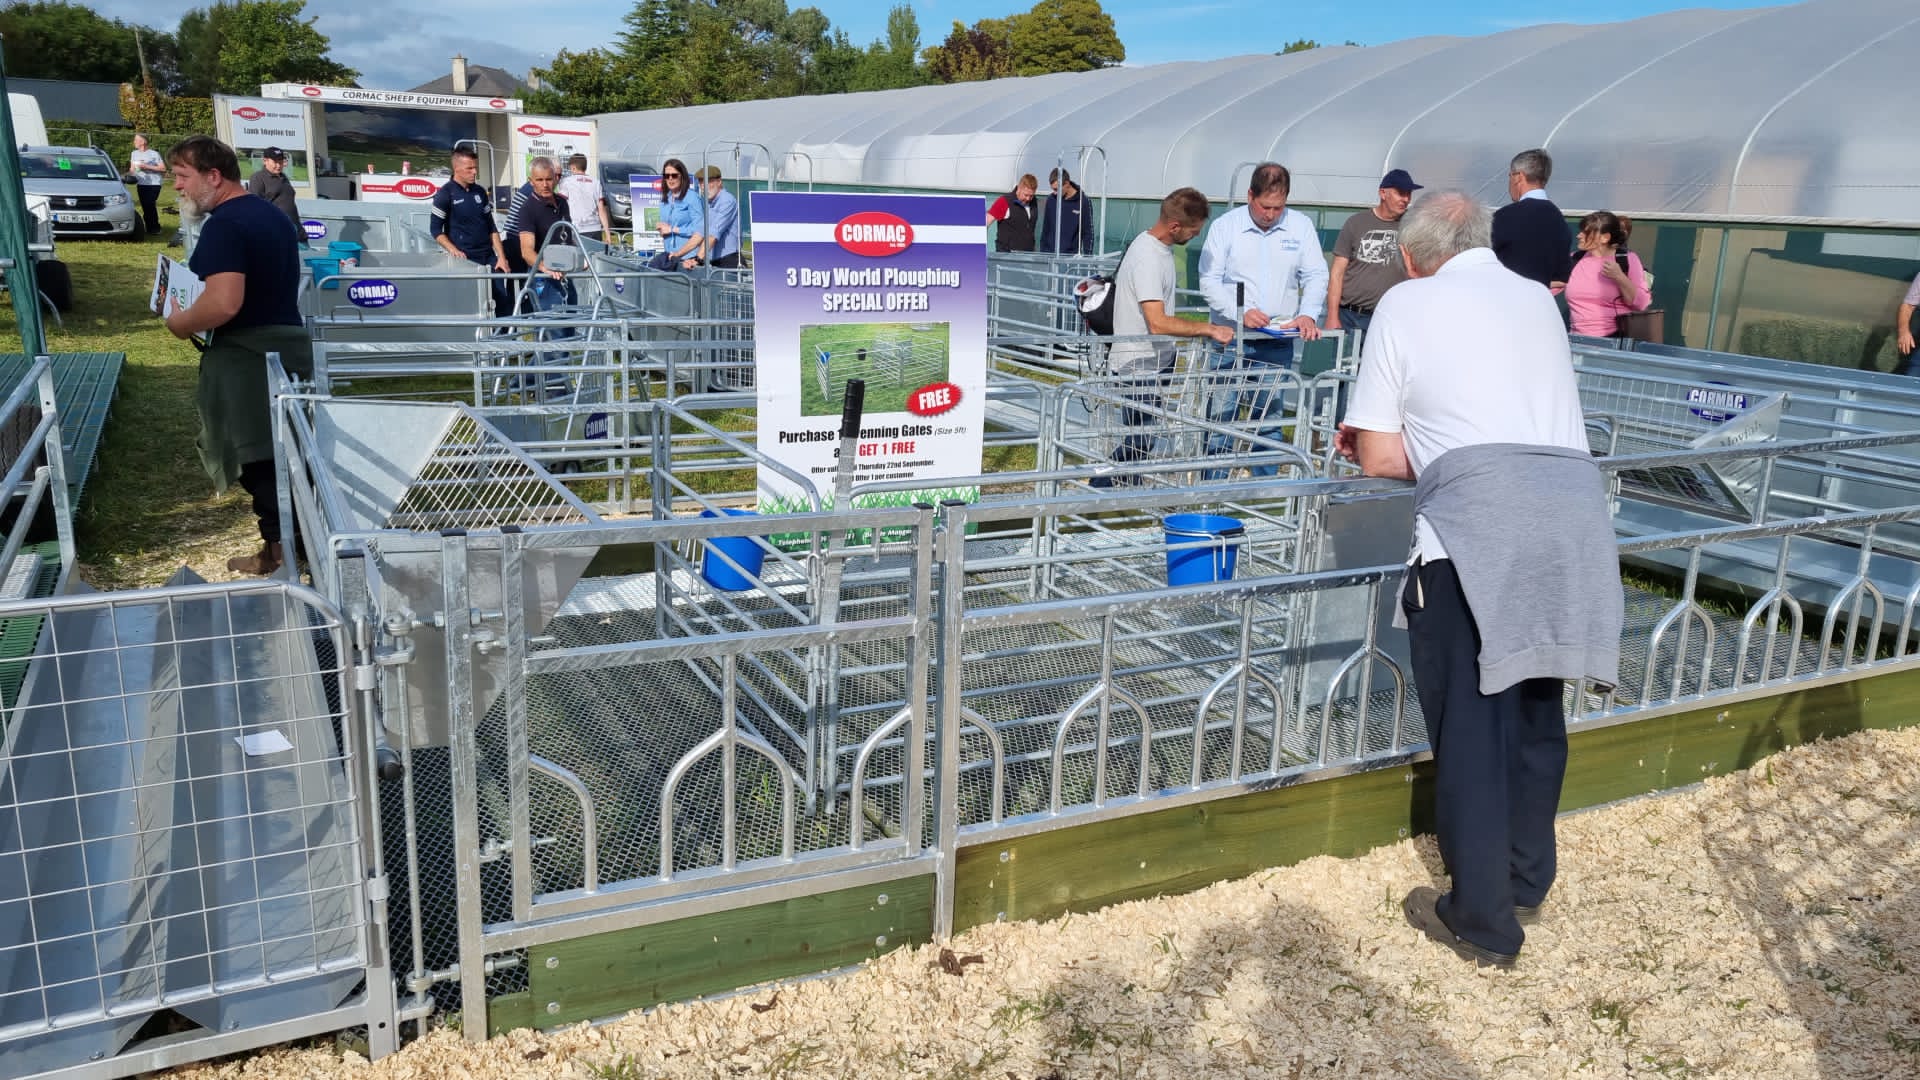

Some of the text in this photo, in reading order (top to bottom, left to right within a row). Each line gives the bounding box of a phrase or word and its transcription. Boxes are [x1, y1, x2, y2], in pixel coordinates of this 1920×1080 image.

[342, 91, 469, 106] CORMAC SHEEP EQUIPMENT
[243, 127, 259, 135] Lamb
[532, 139, 550, 148] Sheep
[402, 184, 431, 194] CORMAC
[842, 223, 906, 243] CORMAC
[786, 267, 961, 289] 3 Day World Ploughing
[350, 285, 395, 299] CORMAC
[822, 292, 929, 313] SPECIAL OFFER
[918, 388, 951, 411] FREE
[1690, 389, 1745, 410] CORMAC
[779, 430, 835, 443] Purchase
[860, 426, 900, 441] enning
[901, 423, 933, 438] Gates
[934, 426, 953, 436] (Size
[858, 440, 916, 457] GET 1 FREE
[810, 466, 824, 474] Offer
[858, 462, 886, 472] Thursday
[886, 461, 901, 470] 22nd
[855, 474, 870, 482] Offer
[875, 473, 886, 481] per
